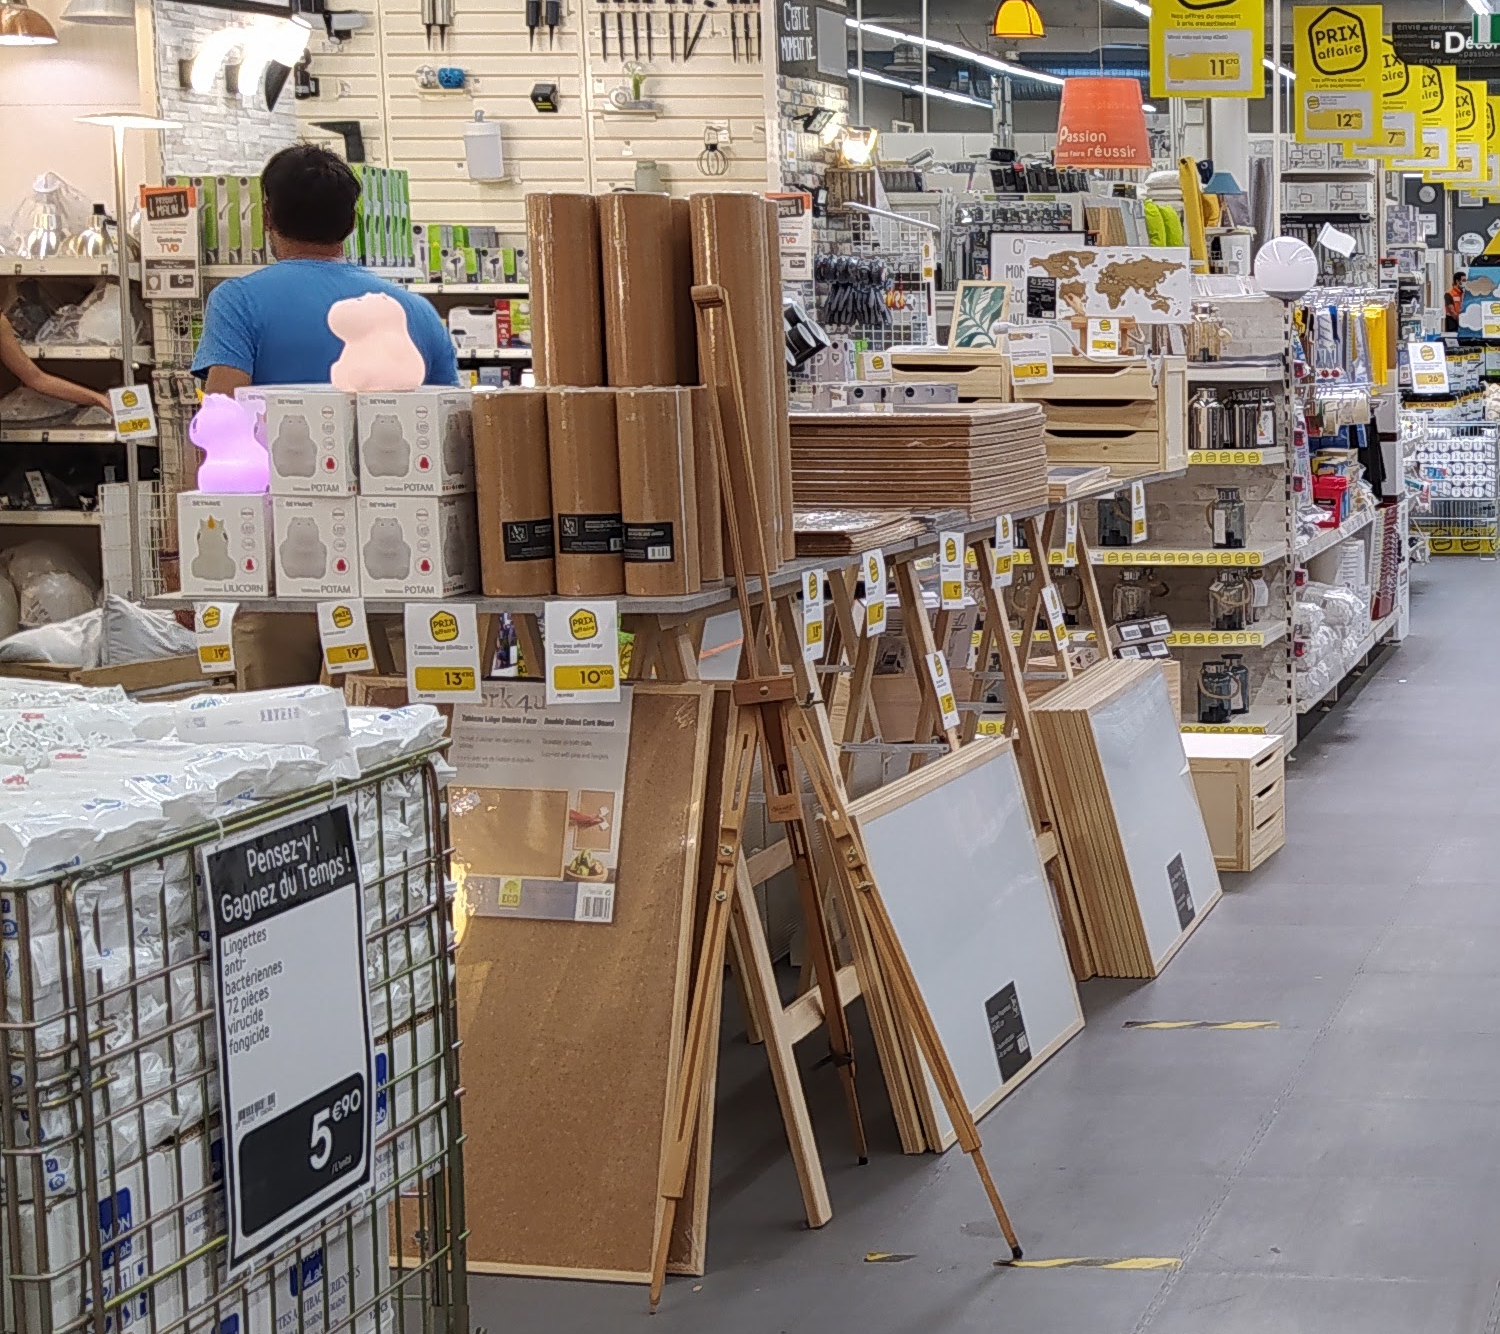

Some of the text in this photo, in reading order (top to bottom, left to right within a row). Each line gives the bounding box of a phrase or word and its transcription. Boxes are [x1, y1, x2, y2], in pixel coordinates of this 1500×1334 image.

[1315, 24, 1361, 46] PRIX
[1087, 144, 1136, 158] réussir
[311, 484, 340, 493] POTAM
[403, 483, 435, 493] POTAM
[320, 585, 351, 594] POTAM
[404, 585, 435, 595] POTAM
[433, 618, 456, 629] PRIX
[572, 617, 594, 628] PRIX
[221, 857, 344, 923] Gagnez du Temps
[223, 927, 268, 958] Lingettes
[224, 958, 283, 995] bactériennes
[227, 986, 270, 1016] 72 pièces
[227, 1008, 264, 1035] virucide
[228, 1023, 270, 1057] fongicide
